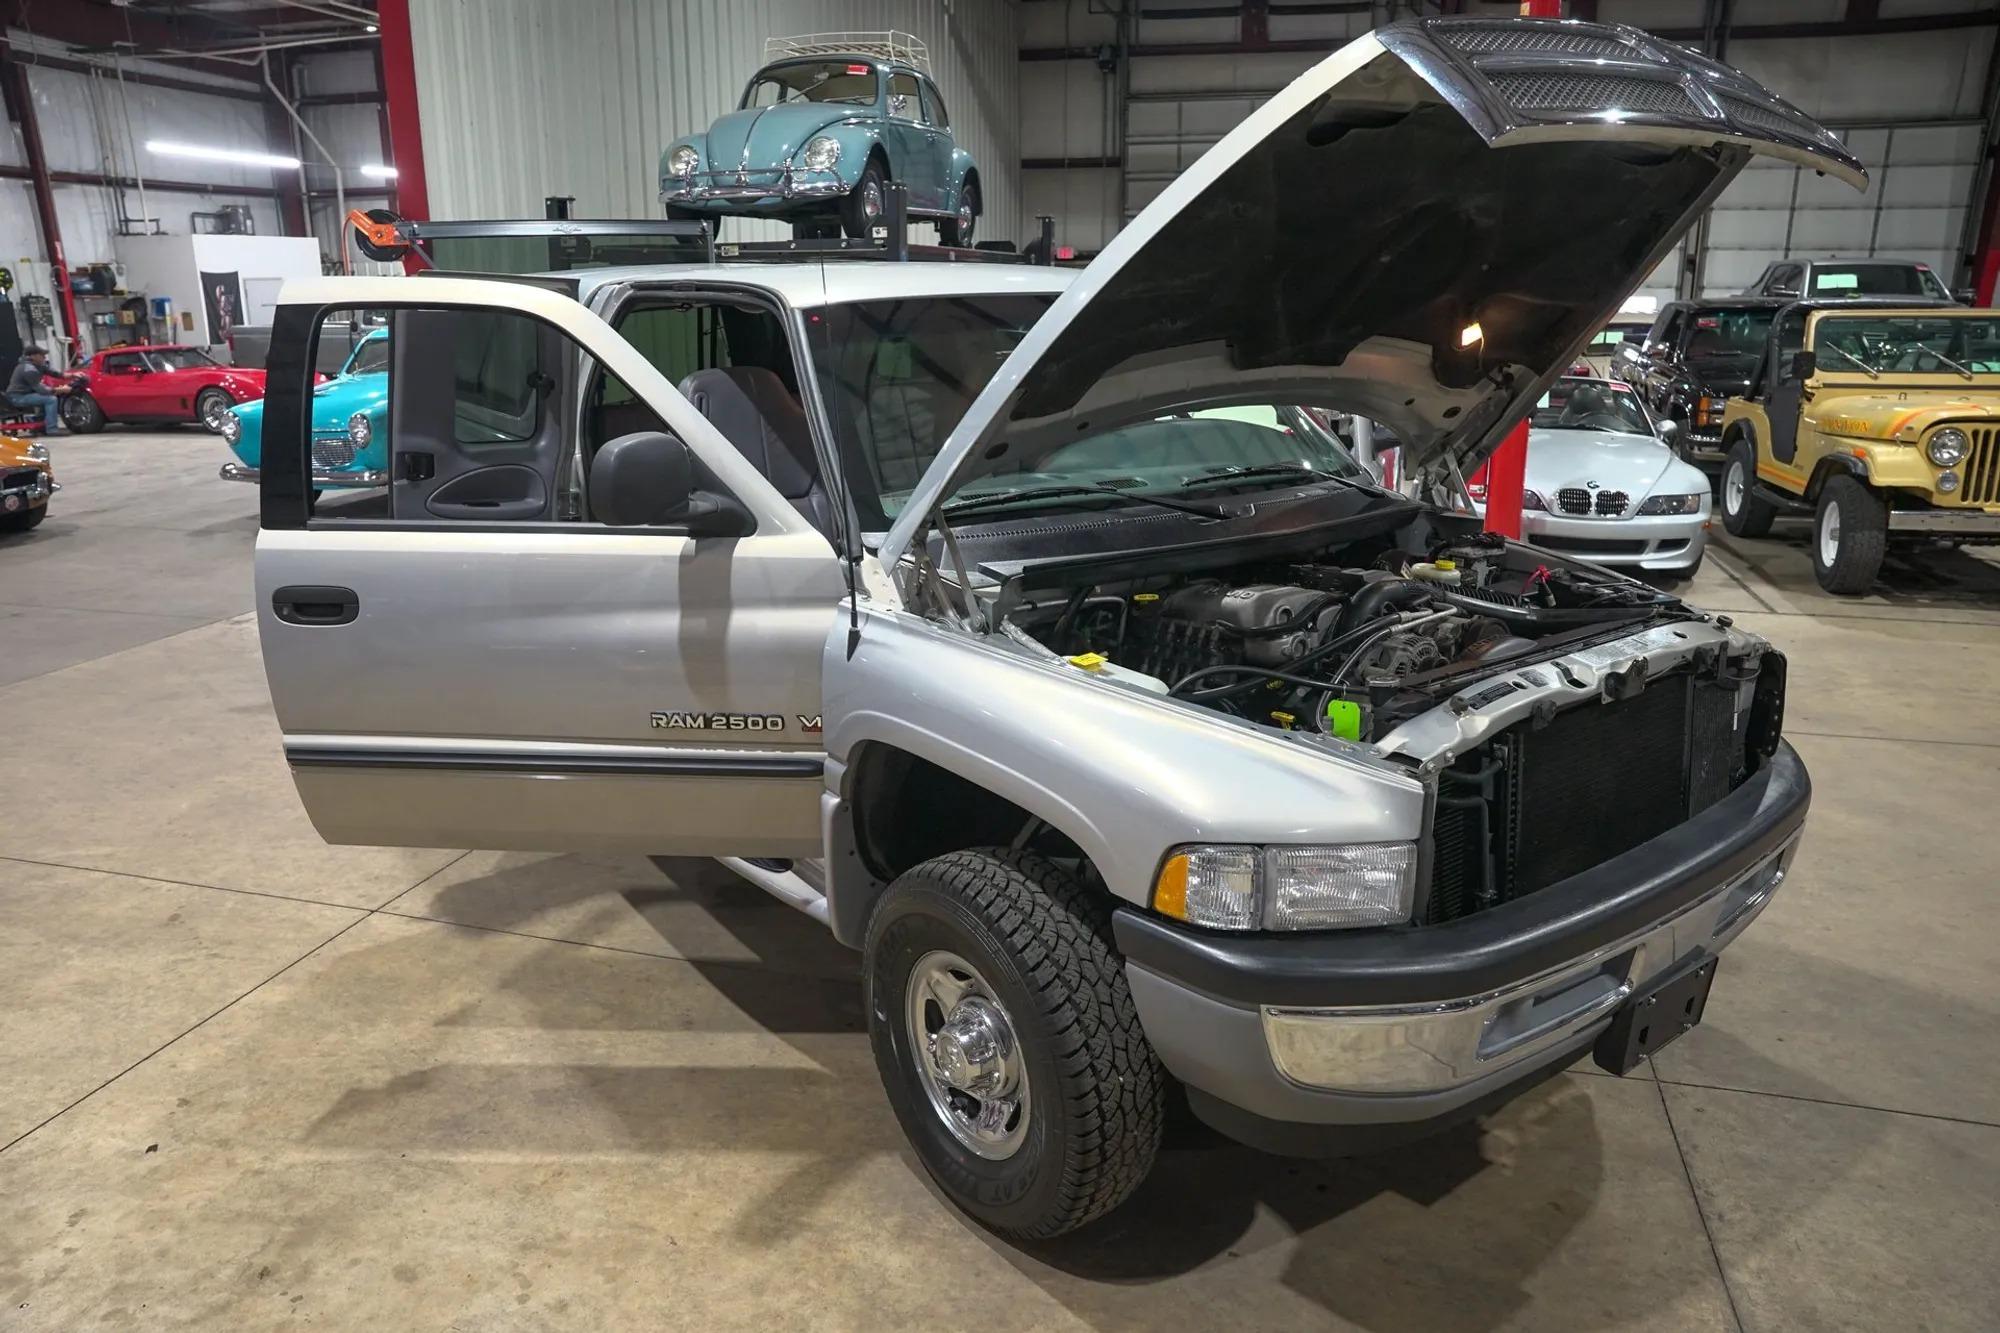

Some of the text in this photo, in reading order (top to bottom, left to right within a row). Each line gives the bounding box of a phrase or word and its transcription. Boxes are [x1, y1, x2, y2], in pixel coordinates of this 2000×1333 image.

[651, 713, 822, 731] RAM 2500 V1
